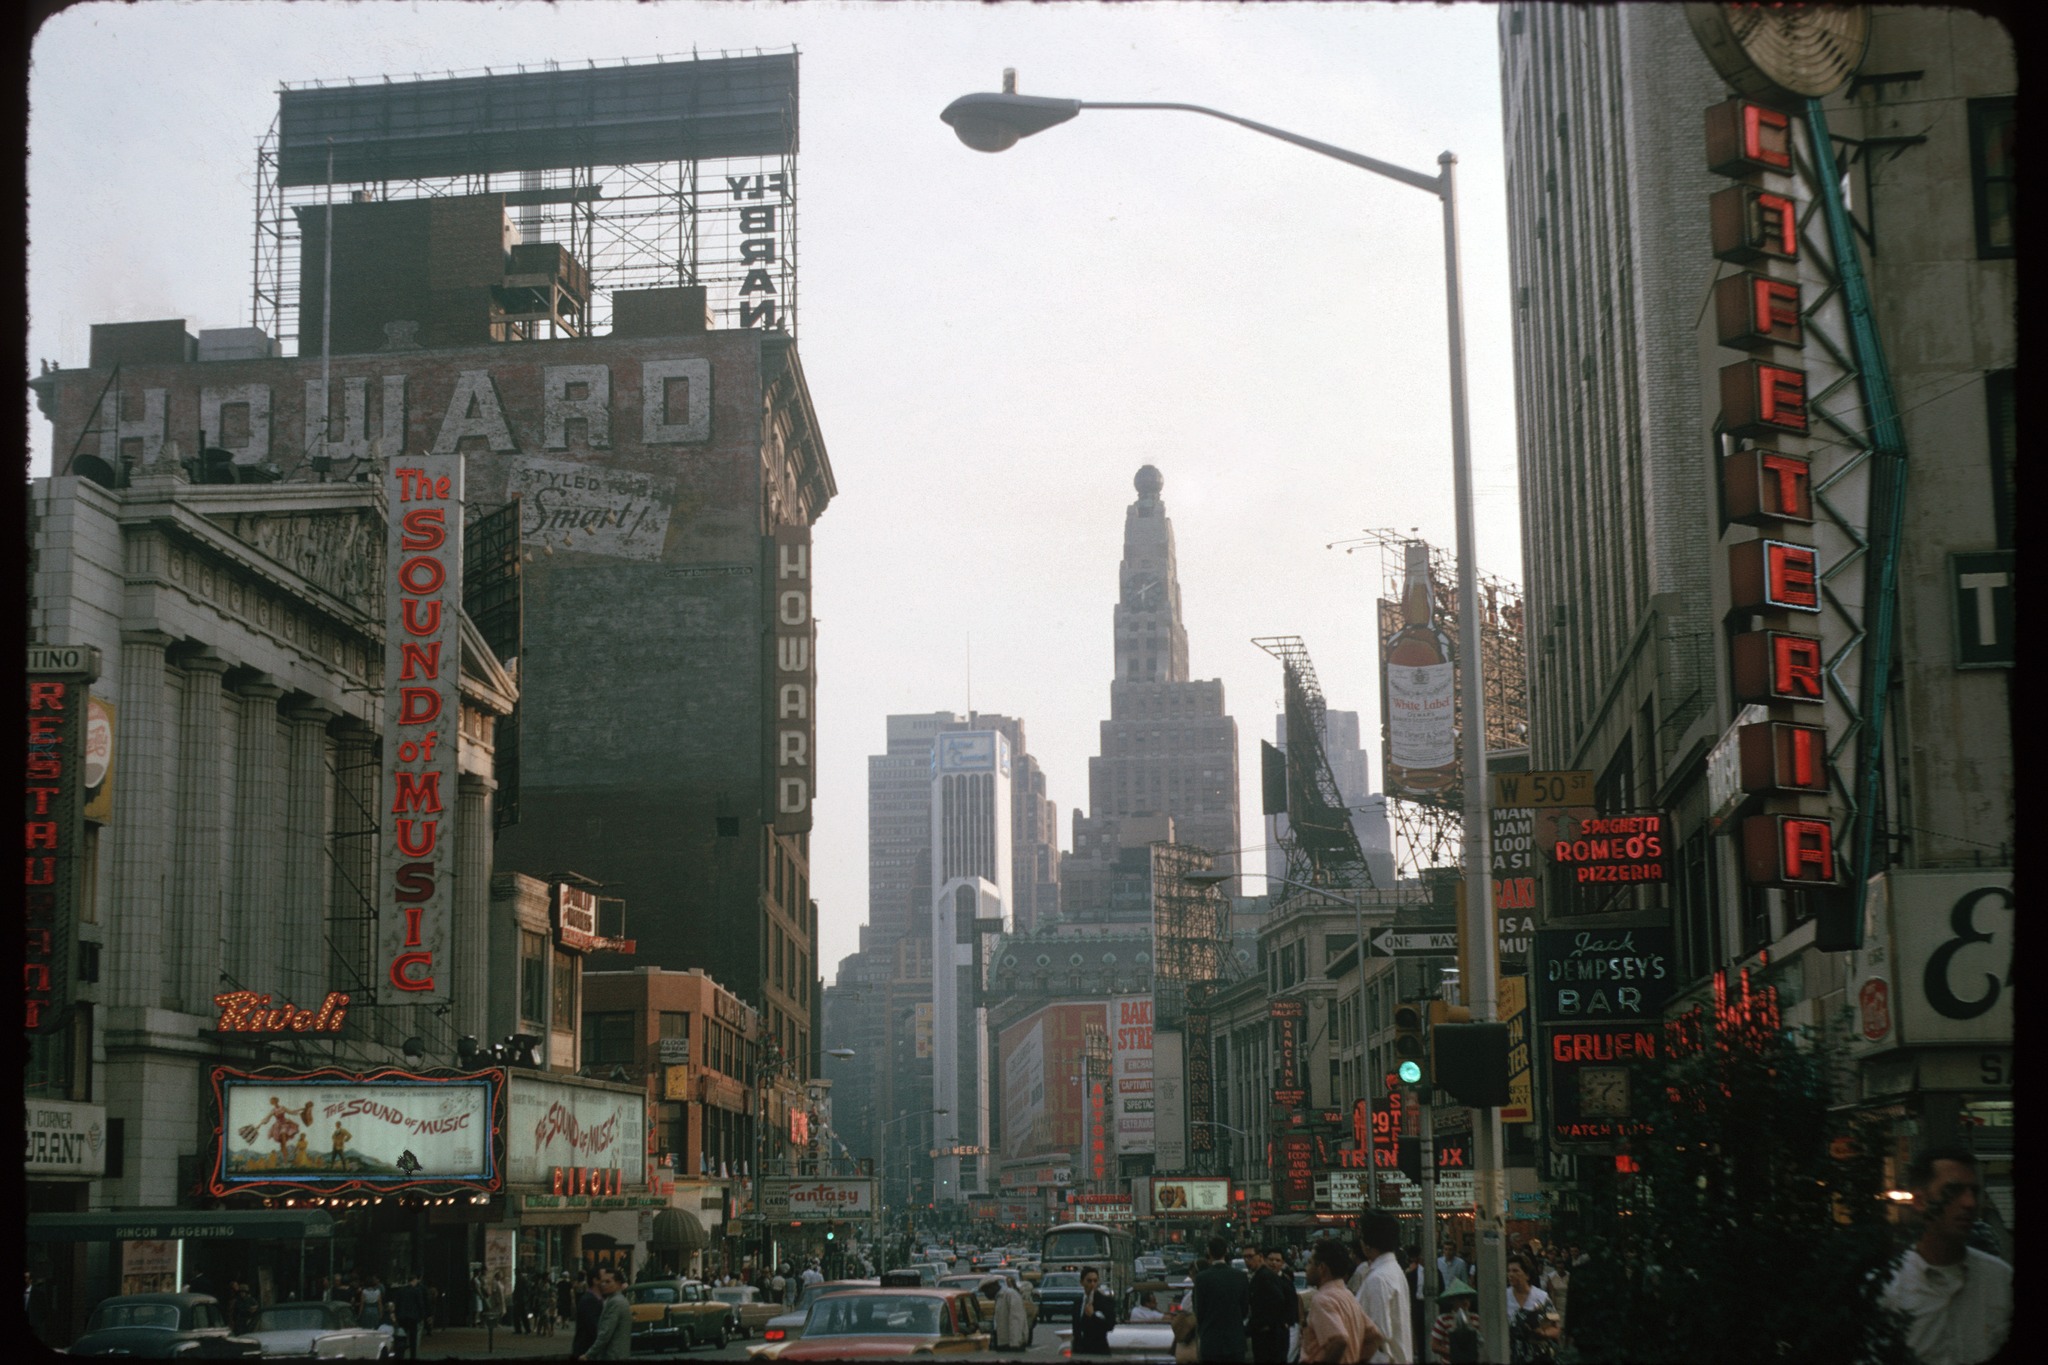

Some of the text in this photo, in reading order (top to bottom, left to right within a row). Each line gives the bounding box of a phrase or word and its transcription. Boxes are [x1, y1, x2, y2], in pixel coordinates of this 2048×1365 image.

[97, 357, 714, 466] HOWARD
[396, 468, 451, 501] The
[520, 468, 599, 491] STYLED
[1743, 104, 1833, 880] CAFETERIA
[398, 508, 446, 725] SOUND
[778, 544, 809, 814] HOWARD
[400, 731, 438, 763] of
[1500, 776, 1587, 804] W 50 ST
[1581, 816, 1661, 835] SPAGHETTI
[1555, 832, 1663, 862] ROMEO'S
[390, 771, 443, 992] MUSIC
[1577, 863, 1663, 883] PIZZERIA
[1521, 917, 1535, 932] A
[1385, 934, 1457, 948] ONE WAY
[1500, 937, 1533, 954] MU
[1568, 931, 1638, 957] Jack
[1548, 952, 1666, 981] DEMPSEY'S
[213, 990, 351, 1032] Rivoli
[1557, 986, 1643, 1015] BAR
[1282, 1020, 1294, 1087] DANCING
[1553, 1032, 1656, 1062] GRUEN
[1188, 1014, 1213, 1152] WARNER
[37, 1110, 72, 1130] CORNER
[322, 1098, 471, 1137] THE SOUND OF MUSIC
[545, 1100, 580, 1150] SOUND
[585, 1112, 616, 1159] MUSIC
[1091, 1083, 1105, 1180] AUTOMAT
[1557, 1123, 1611, 1136] WATCH
[552, 1167, 622, 1197] RIVOLI
[764, 1196, 789, 1206] CARDS
[115, 1225, 235, 1238] RINCON ARGENTINO
